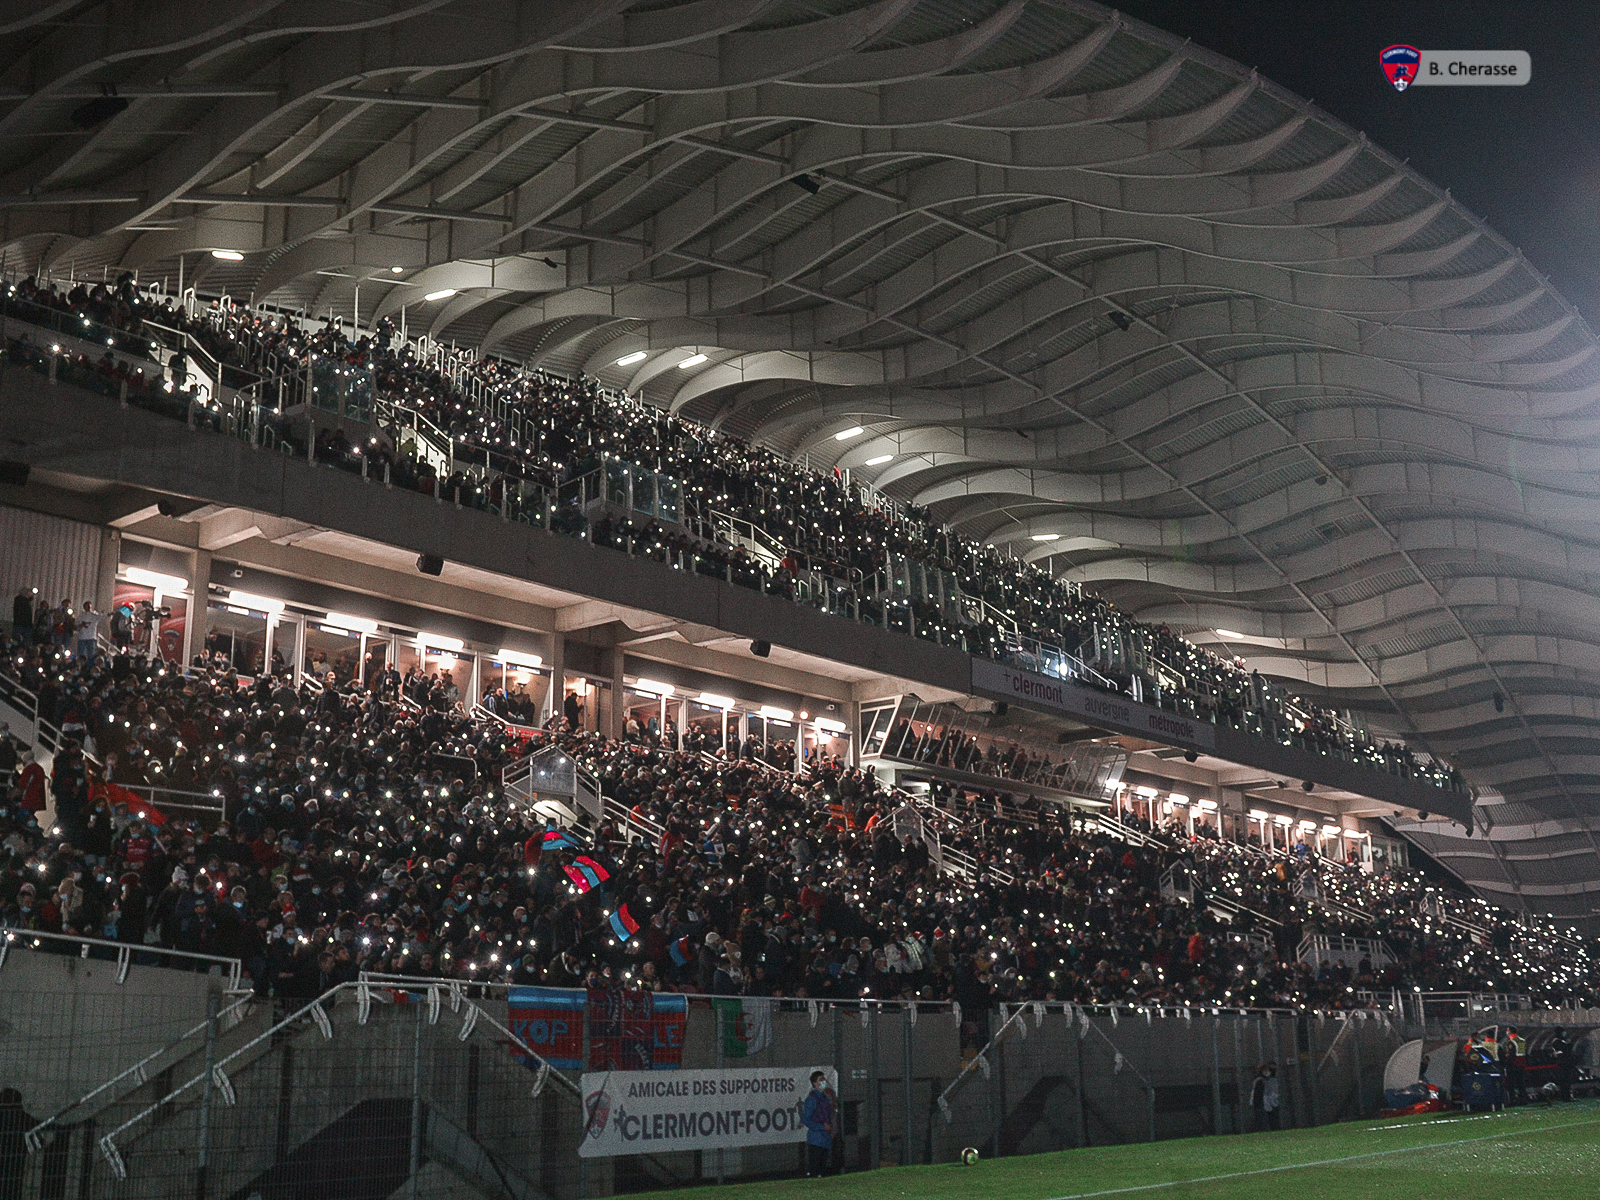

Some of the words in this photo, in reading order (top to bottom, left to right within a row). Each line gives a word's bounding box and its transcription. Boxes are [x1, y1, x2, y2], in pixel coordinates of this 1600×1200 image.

[1012, 675, 1063, 703] clermont
[1085, 697, 1129, 722] auvergne
[1149, 713, 1194, 739] métropole
[513, 1019, 568, 1046] KOP
[628, 1081, 688, 1097] AMICALE
[693, 1081, 716, 1096] DES
[720, 1077, 795, 1095] SUPPORTERS
